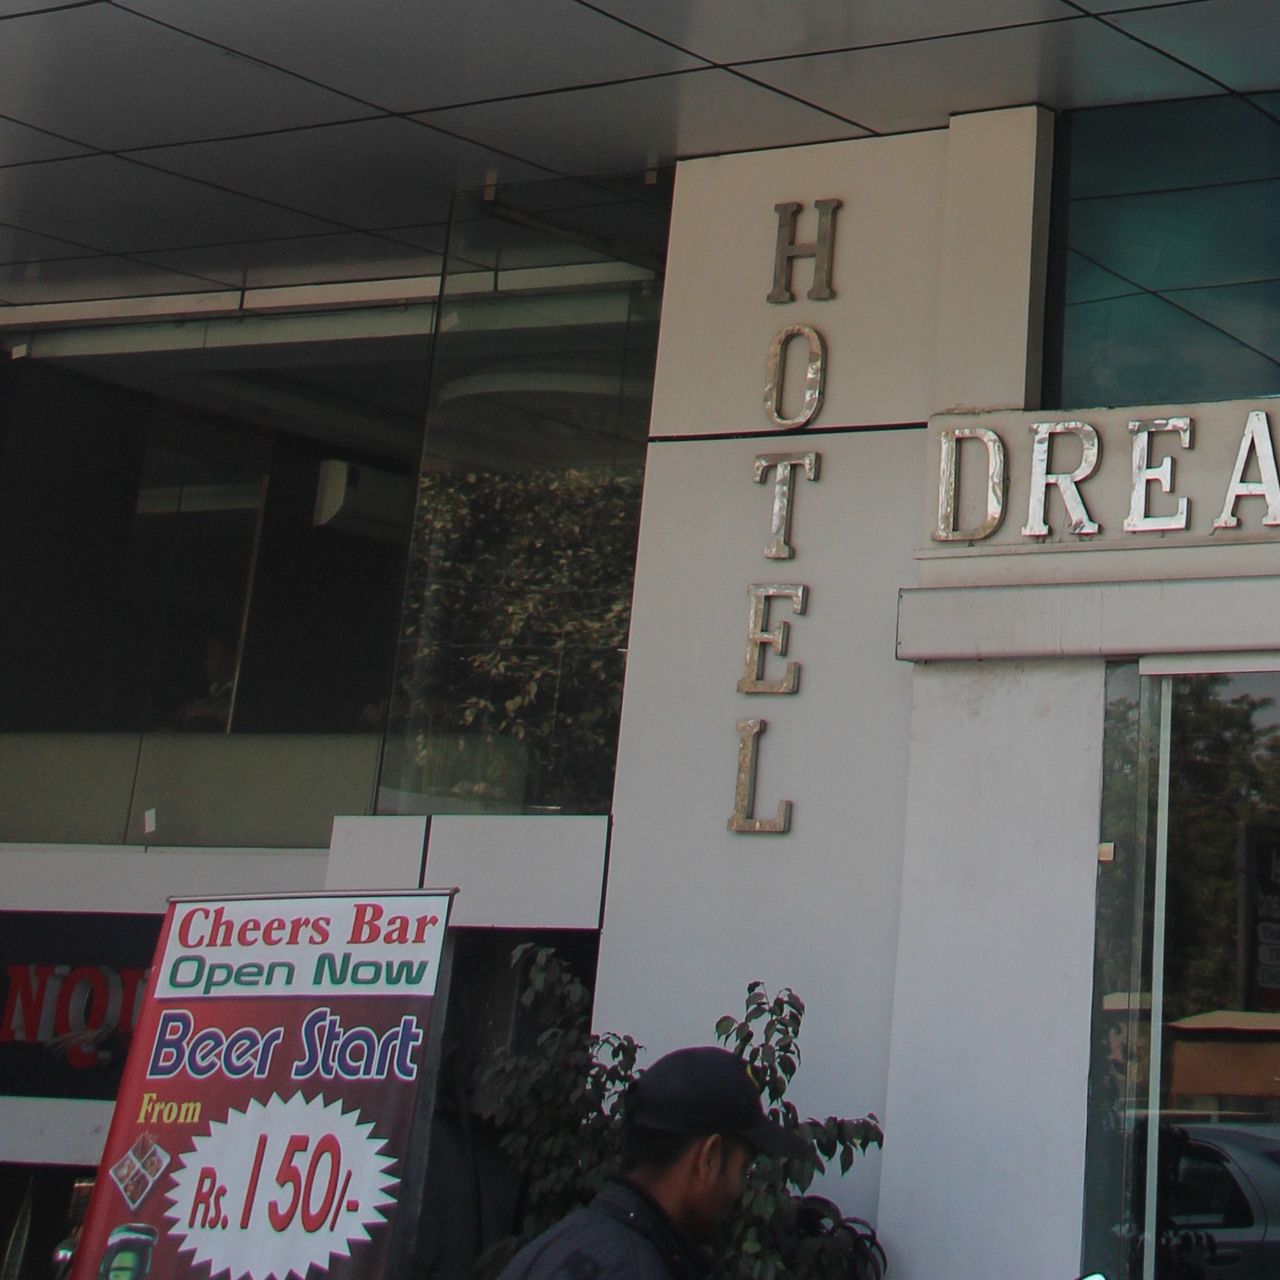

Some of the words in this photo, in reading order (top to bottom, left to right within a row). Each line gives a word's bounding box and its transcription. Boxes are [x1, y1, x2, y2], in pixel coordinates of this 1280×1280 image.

[727, 197, 842, 837] HOTEL
[178, 906, 331, 949] Cheers
[346, 903, 439, 946] Bar
[168, 954, 296, 995] Open
[312, 952, 430, 987] Now
[146, 1008, 286, 1081] Beer
[291, 1006, 424, 1082] Start
[136, 1093, 202, 1125] From
